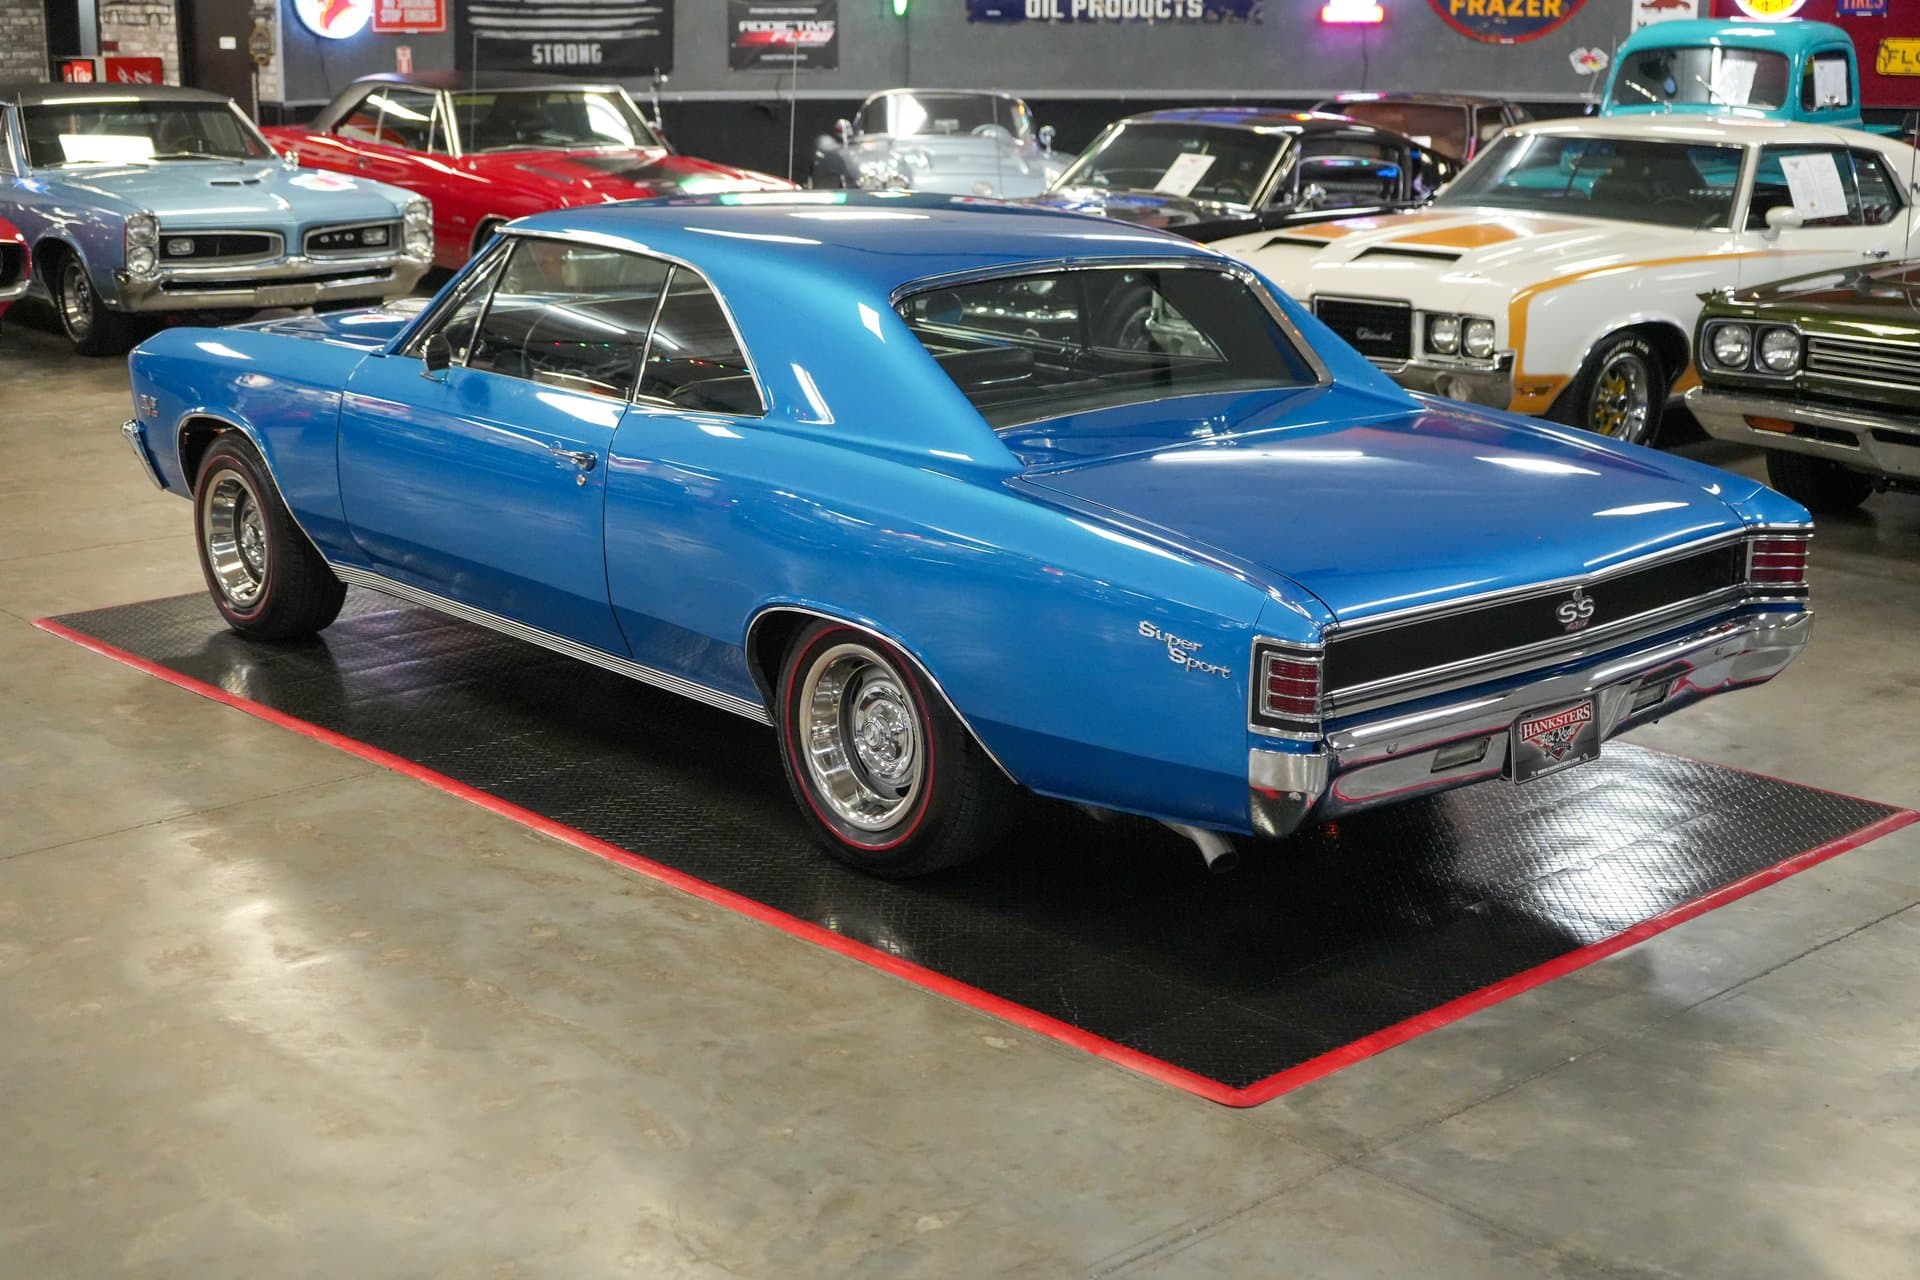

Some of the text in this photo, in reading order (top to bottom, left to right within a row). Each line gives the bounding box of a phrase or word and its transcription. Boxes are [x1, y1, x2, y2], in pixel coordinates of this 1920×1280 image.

[1025, 0, 1204, 18] OIL PRODUCTS
[1449, 0, 1562, 17] FRAZER
[532, 43, 602, 64] STRONG
[1138, 620, 1204, 650] Super
[1168, 647, 1231, 679] Sport
[1523, 704, 1590, 739] HANKSTERS
